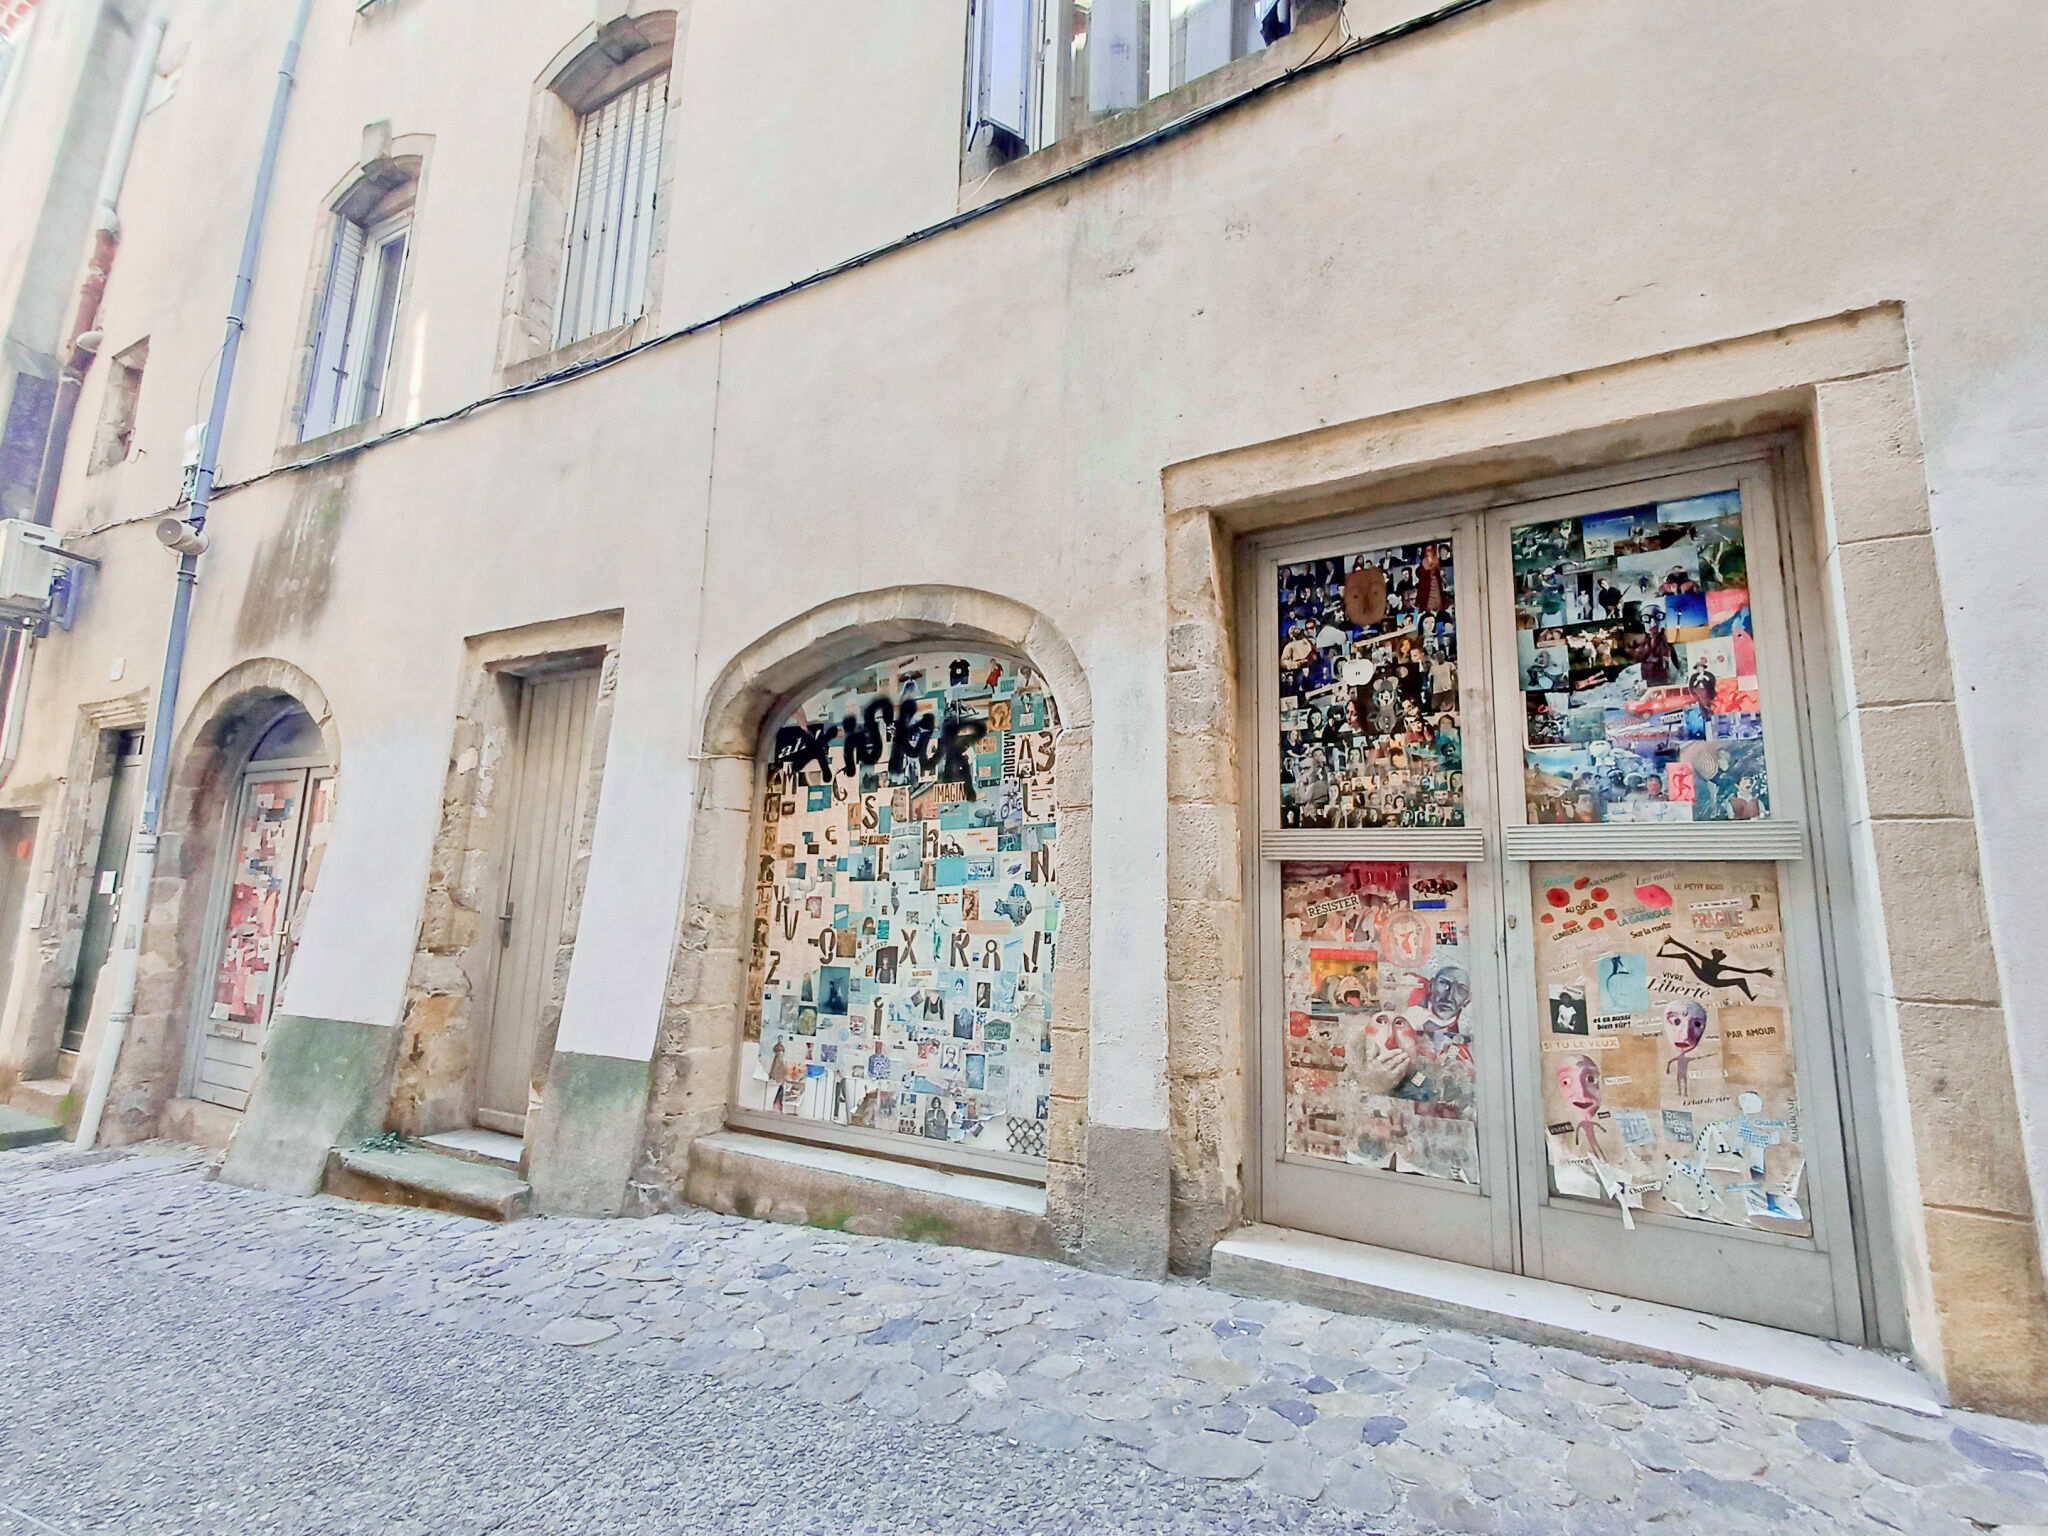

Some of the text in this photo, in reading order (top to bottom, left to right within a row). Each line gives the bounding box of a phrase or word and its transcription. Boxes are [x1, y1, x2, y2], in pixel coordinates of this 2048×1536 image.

[1002, 730, 1016, 779] MAGIQUE
[861, 795, 879, 829] S
[1307, 896, 1360, 918] RESISTER
[1692, 911, 1744, 928] FRAGILE
[1630, 921, 1672, 939] Sur la route
[1663, 972, 1684, 982] VIVRE
[1647, 978, 1710, 999] Liberté
[1726, 1031, 1743, 1039] PAR
[1745, 1026, 1777, 1036] AMOUR
[1556, 1041, 1570, 1049] TU
[1573, 1040, 1585, 1048] LE
